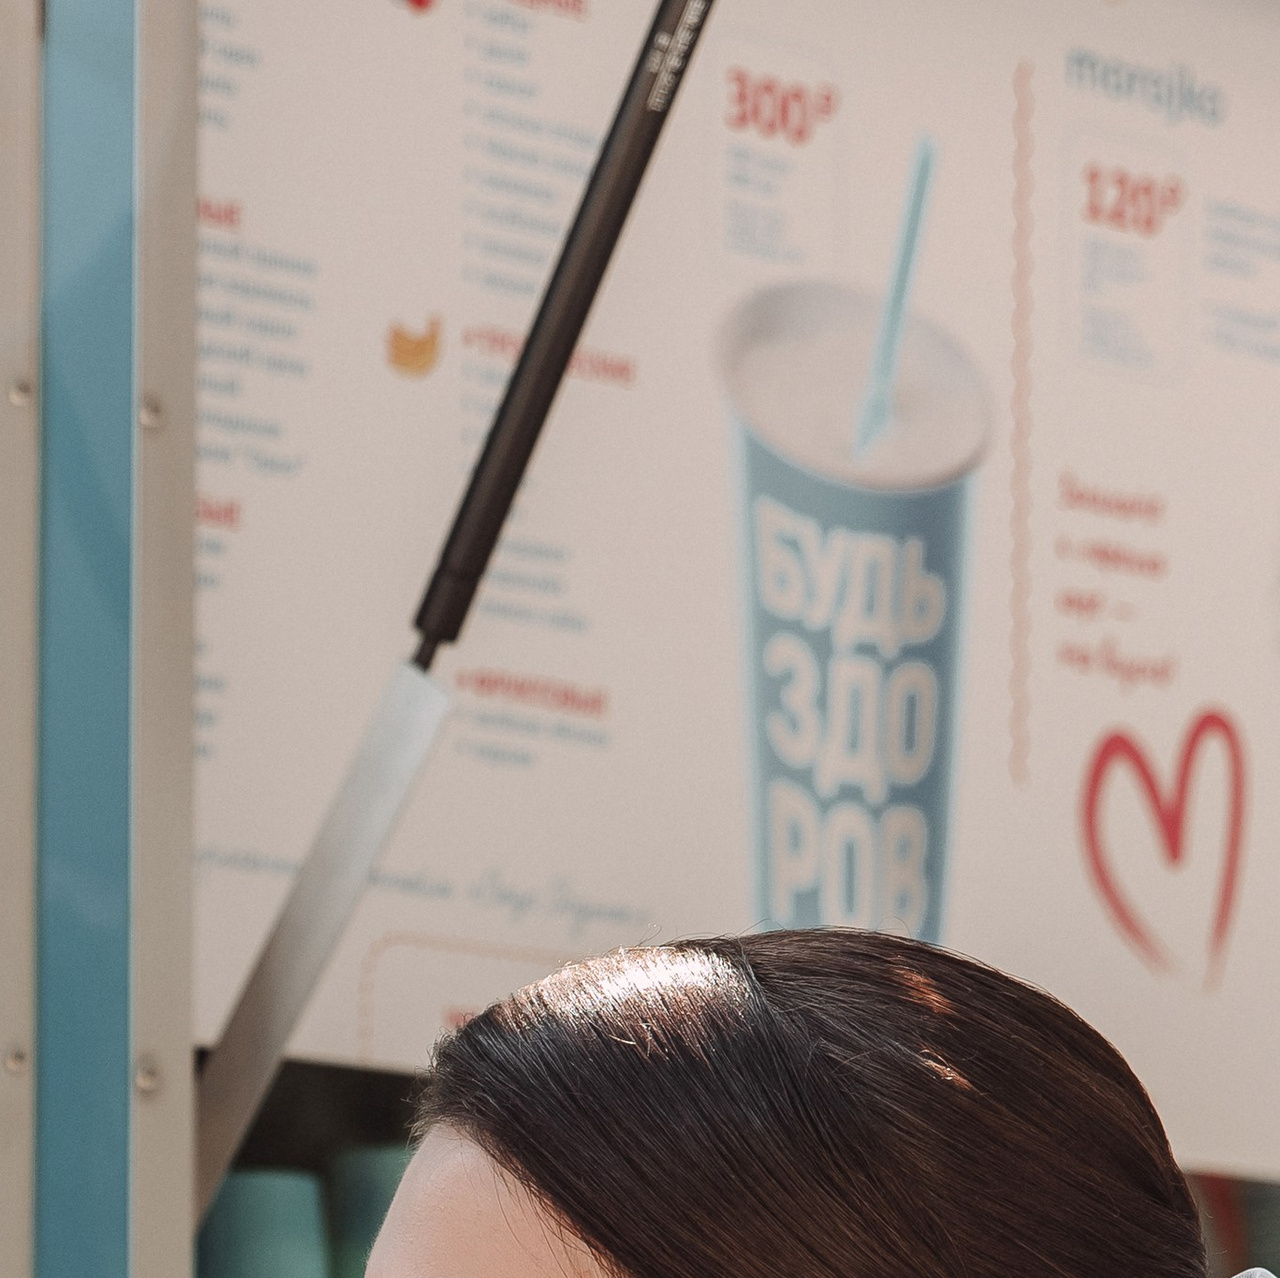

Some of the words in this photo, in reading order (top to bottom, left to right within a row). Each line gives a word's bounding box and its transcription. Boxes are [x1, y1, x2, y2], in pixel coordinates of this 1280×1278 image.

[757, 496, 947, 659] БУДЬ
[763, 632, 939, 806] ЗДО
[769, 778, 929, 940] РОВ
